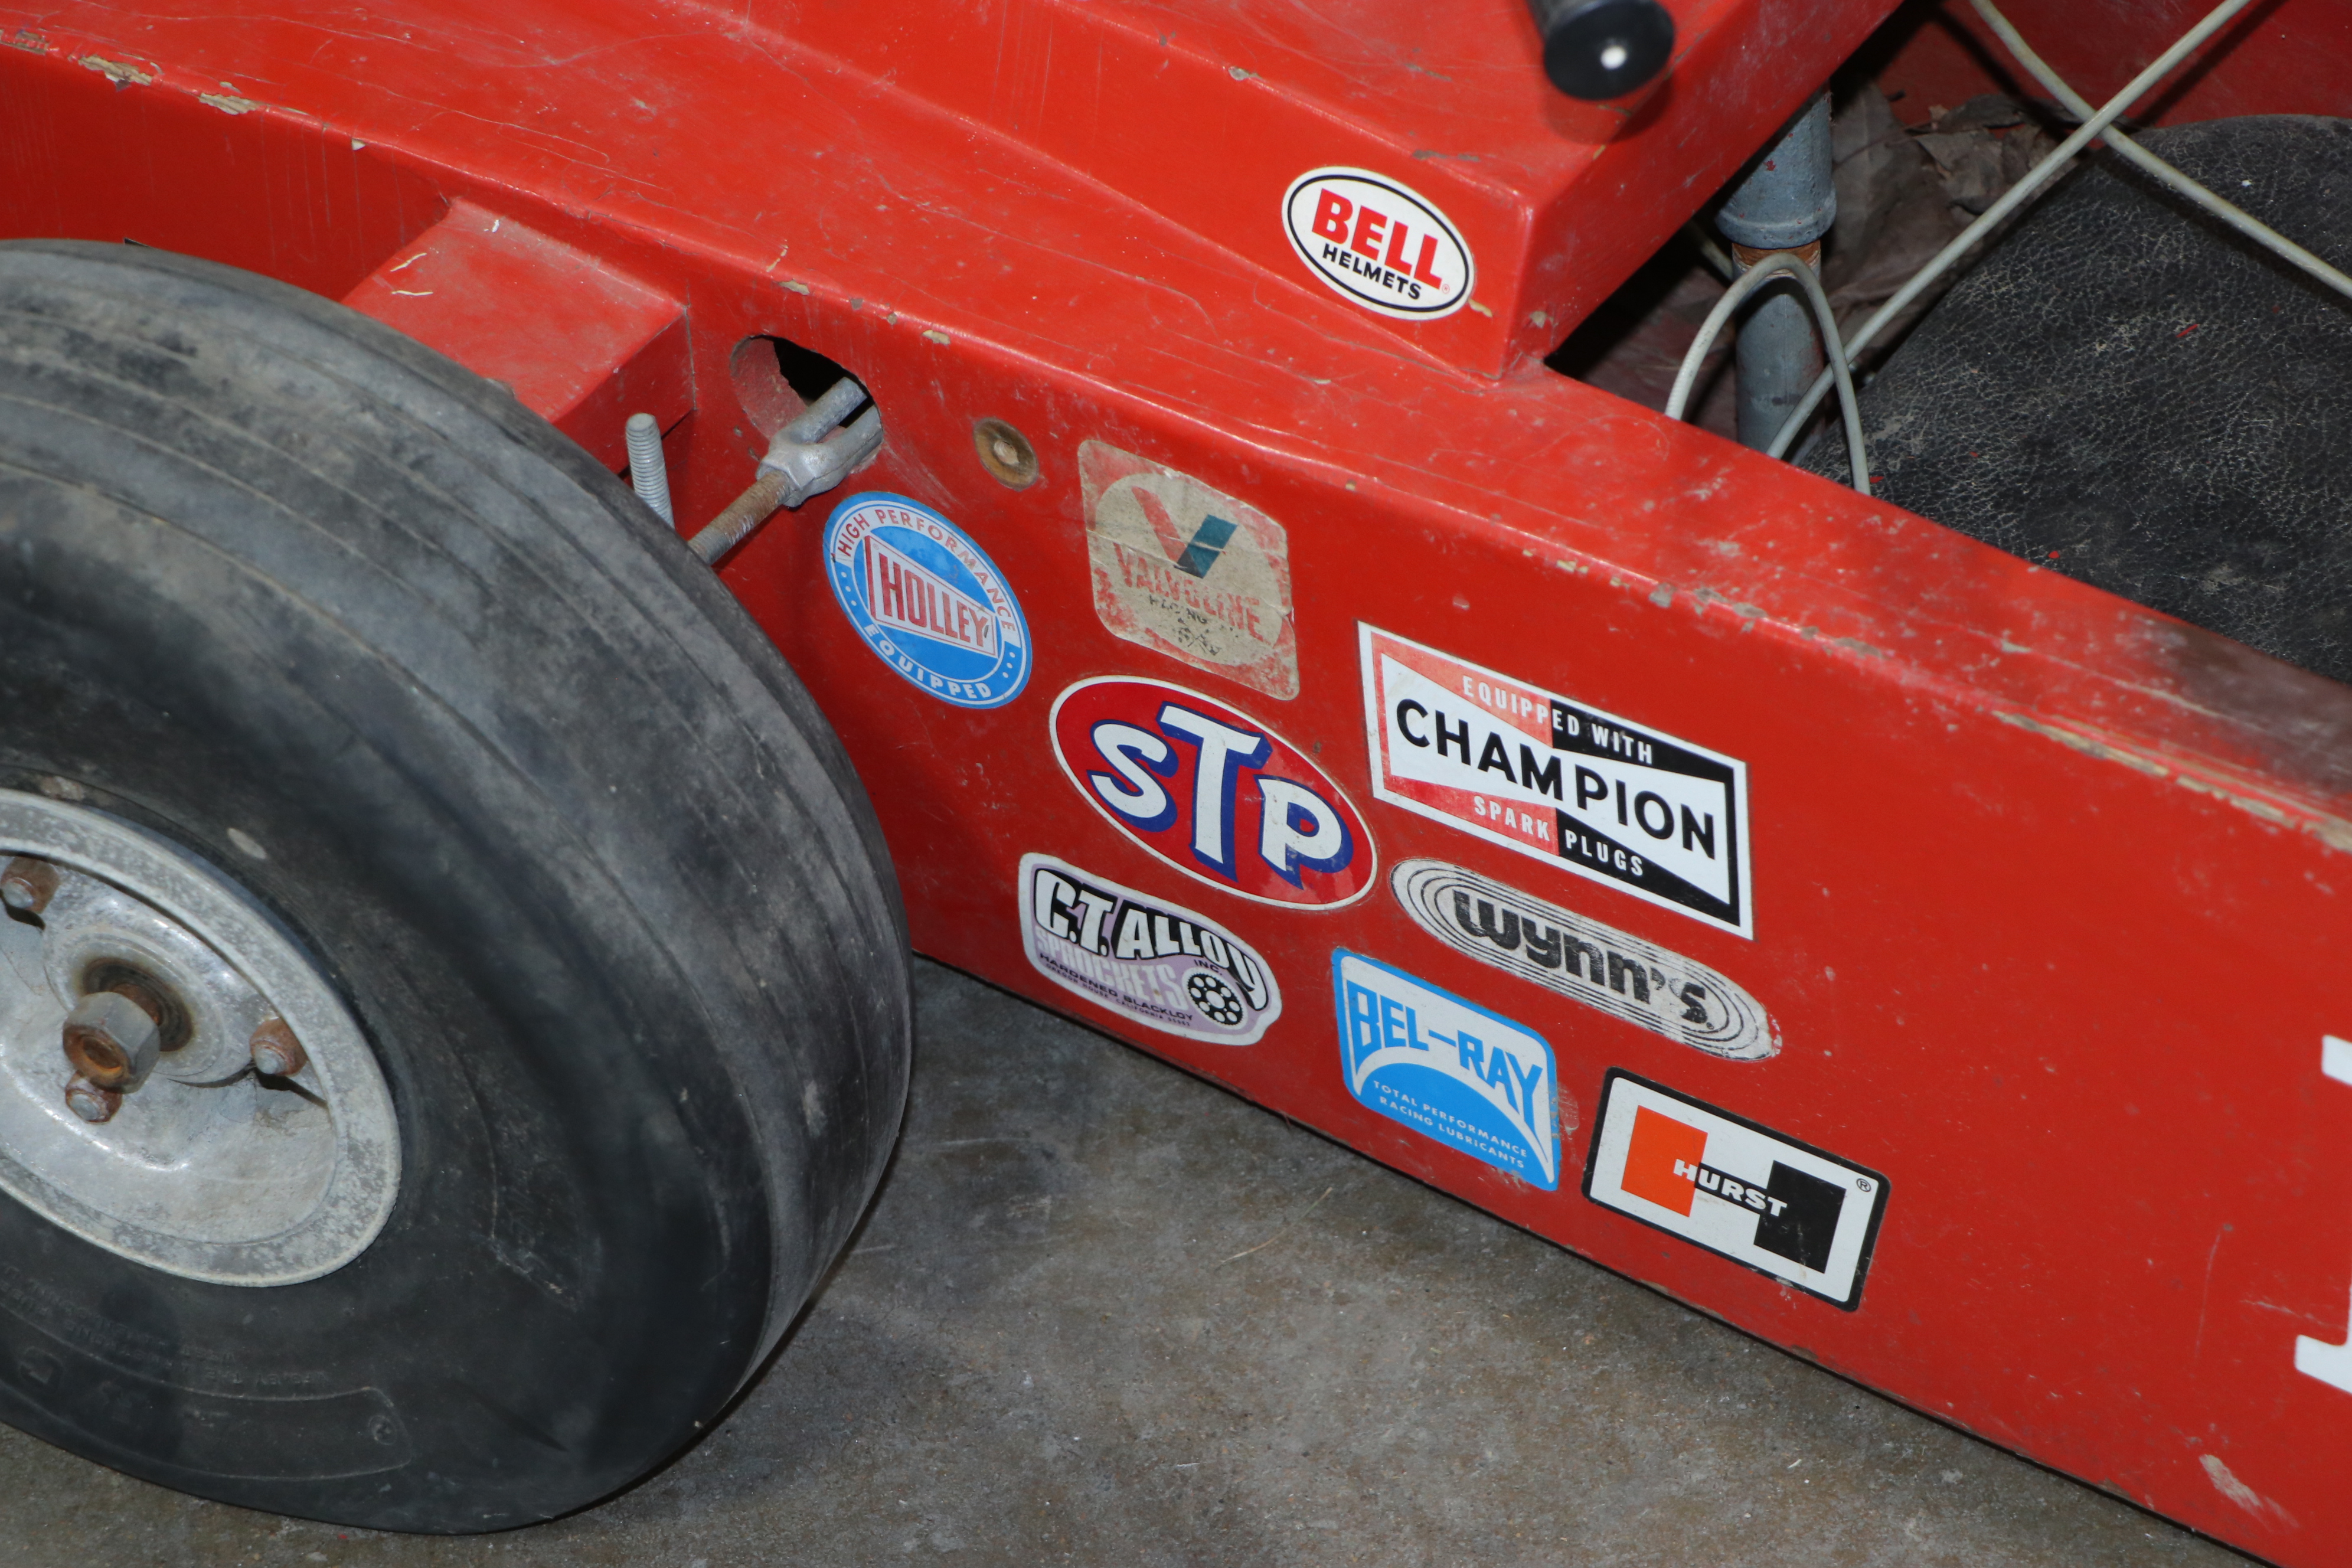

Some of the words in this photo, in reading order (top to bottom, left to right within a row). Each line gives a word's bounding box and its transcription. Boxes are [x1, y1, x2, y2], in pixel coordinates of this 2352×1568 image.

[1312, 188, 1442, 290] BELL
[1322, 243, 1422, 299] HELMETS
[838, 514, 870, 557] HIGH
[875, 509, 1015, 632] PERFORMANCE
[879, 553, 989, 647] HOLLEY
[864, 624, 992, 698] EQUIPPED
[1462, 675, 1580, 737] EQUIPPED
[1592, 724, 1652, 765] WITH
[1087, 701, 1354, 890] STP
[1396, 699, 1715, 860] CHAMPION
[1474, 796, 1550, 841] SPARK
[1566, 828, 1643, 876] PLUGS
[1034, 925, 1188, 1011] SPROCKETS
[1040, 953, 1118, 997] HARDENED
[1123, 995, 1193, 1021] BLACKLOY
[1113, 901, 1269, 1011] ALLOY
[1194, 959, 1222, 975] INC.
[1347, 979, 1548, 1163] BEL-RAY
[1373, 1080, 1417, 1106] TOTAL
[1423, 1104, 1527, 1157] PERFORMANCE
[1380, 1096, 1433, 1126] RACING
[1439, 1123, 1524, 1168] LUBRICANTS
[1673, 1158, 1787, 1217] HURST
